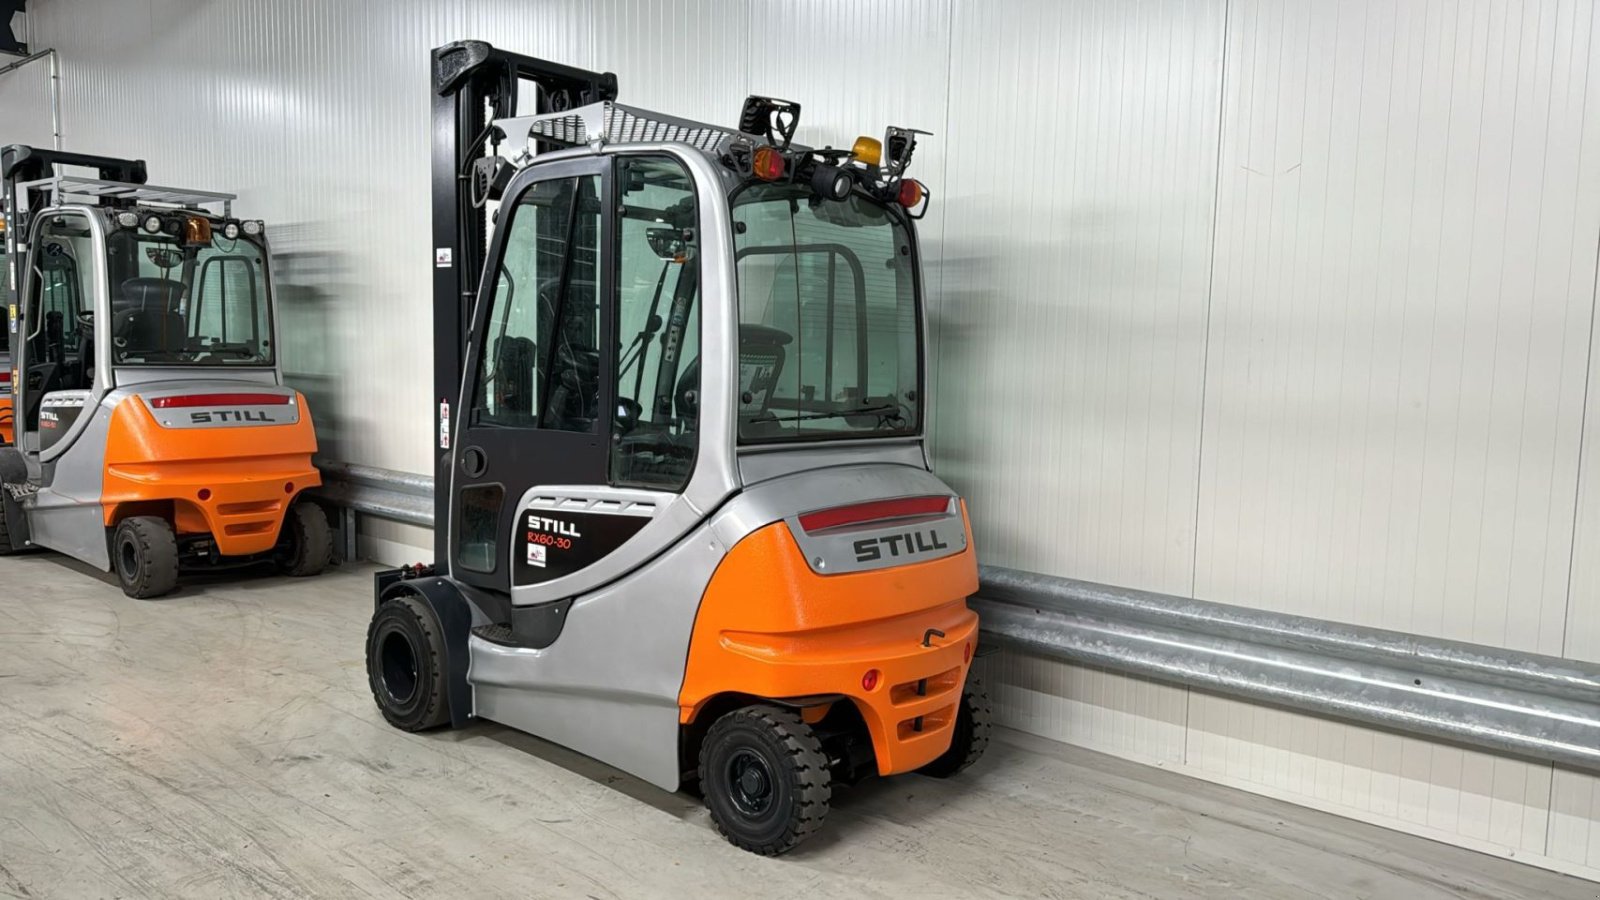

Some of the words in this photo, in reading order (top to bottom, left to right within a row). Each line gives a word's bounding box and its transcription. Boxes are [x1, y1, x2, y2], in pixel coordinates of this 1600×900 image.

[40, 410, 59, 421] STILL
[190, 410, 275, 423] STILL
[528, 515, 581, 537] STILL
[527, 531, 571, 549] RX60-30
[853, 530, 947, 562] STILL
